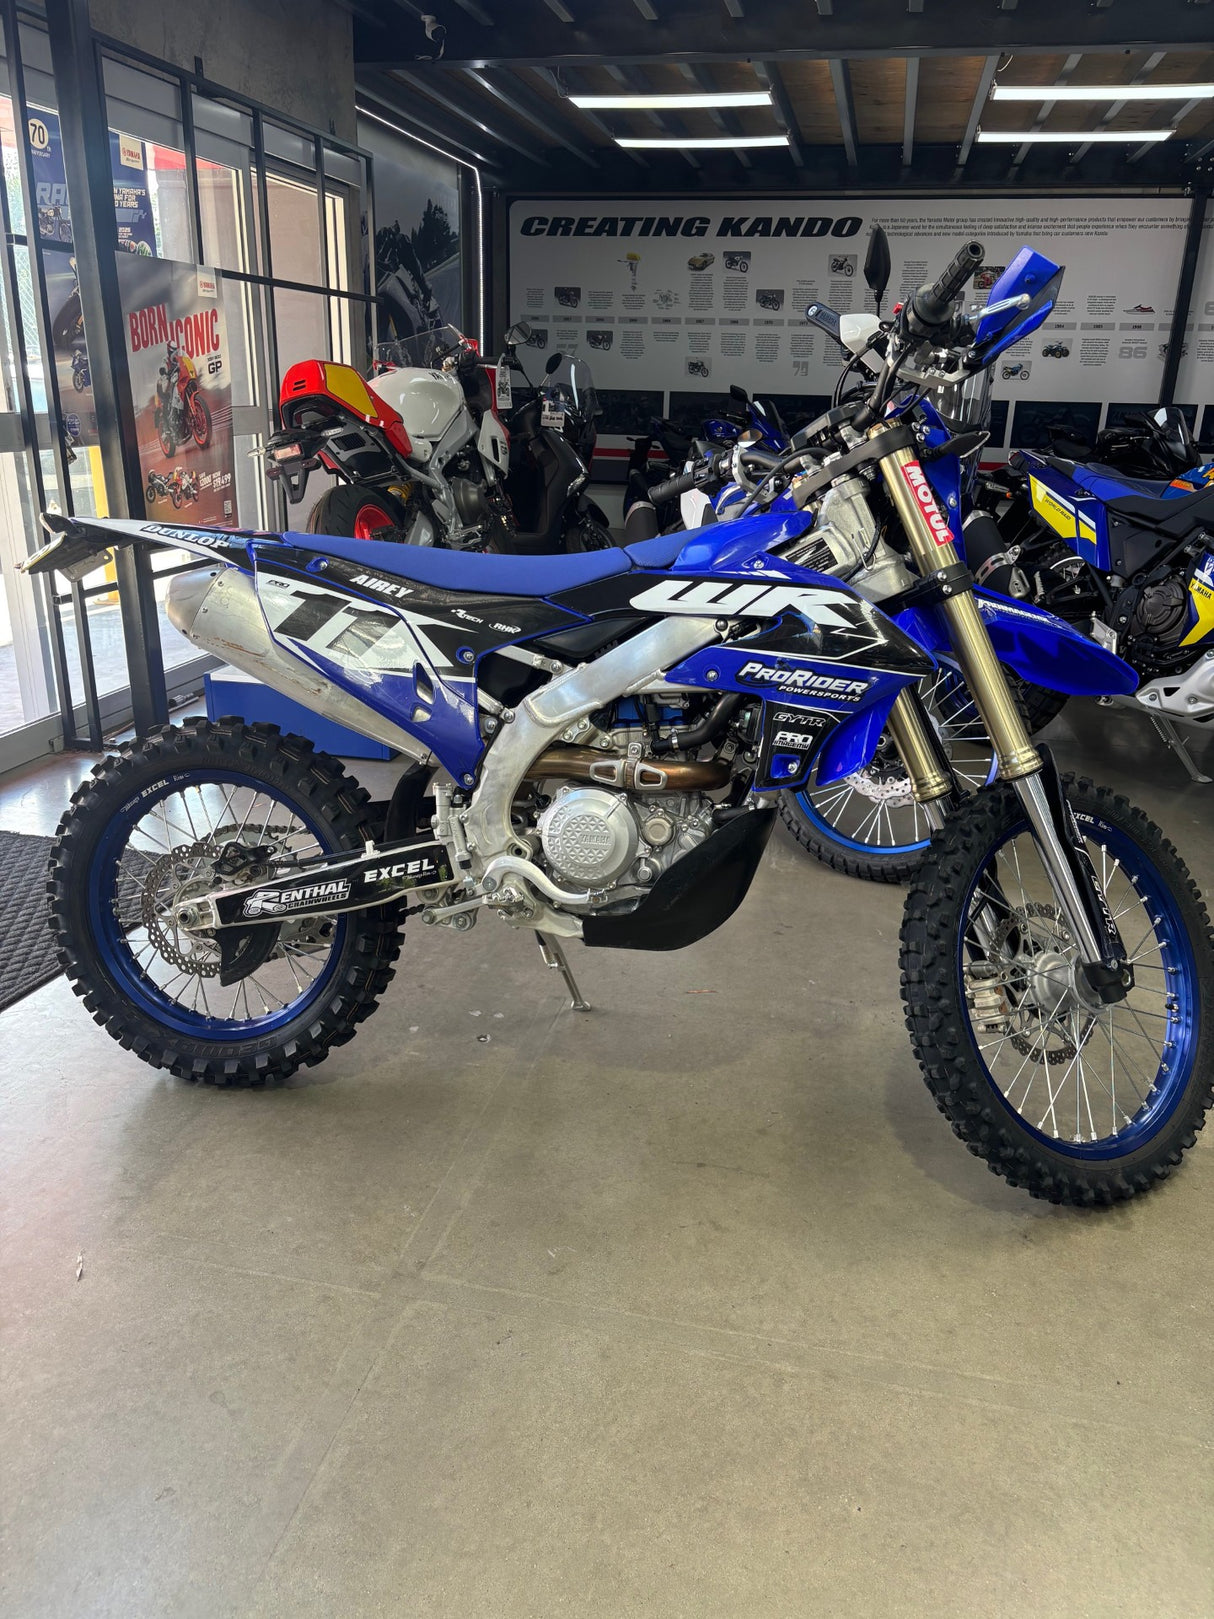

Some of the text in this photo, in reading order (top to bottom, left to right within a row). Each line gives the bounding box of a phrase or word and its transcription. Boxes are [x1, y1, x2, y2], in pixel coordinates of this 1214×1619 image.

[30, 122, 45, 145] 70
[519, 216, 863, 238] CREATING KANDO
[129, 303, 220, 360] BORN ICONIC
[1118, 347, 1148, 359] 86
[208, 360, 222, 375] GP
[905, 465, 950, 543] MOTUL
[142, 524, 230, 550] DUNLOP
[350, 574, 414, 599] AIREY
[629, 579, 859, 630] WR
[778, 685, 862, 703] POWERSPORTS
[772, 711, 827, 728] GYTR
[775, 730, 814, 747] PRO
[141, 779, 170, 799] EXCEL
[363, 858, 435, 884] EXCEL
[246, 881, 349, 915] RENTHAL
